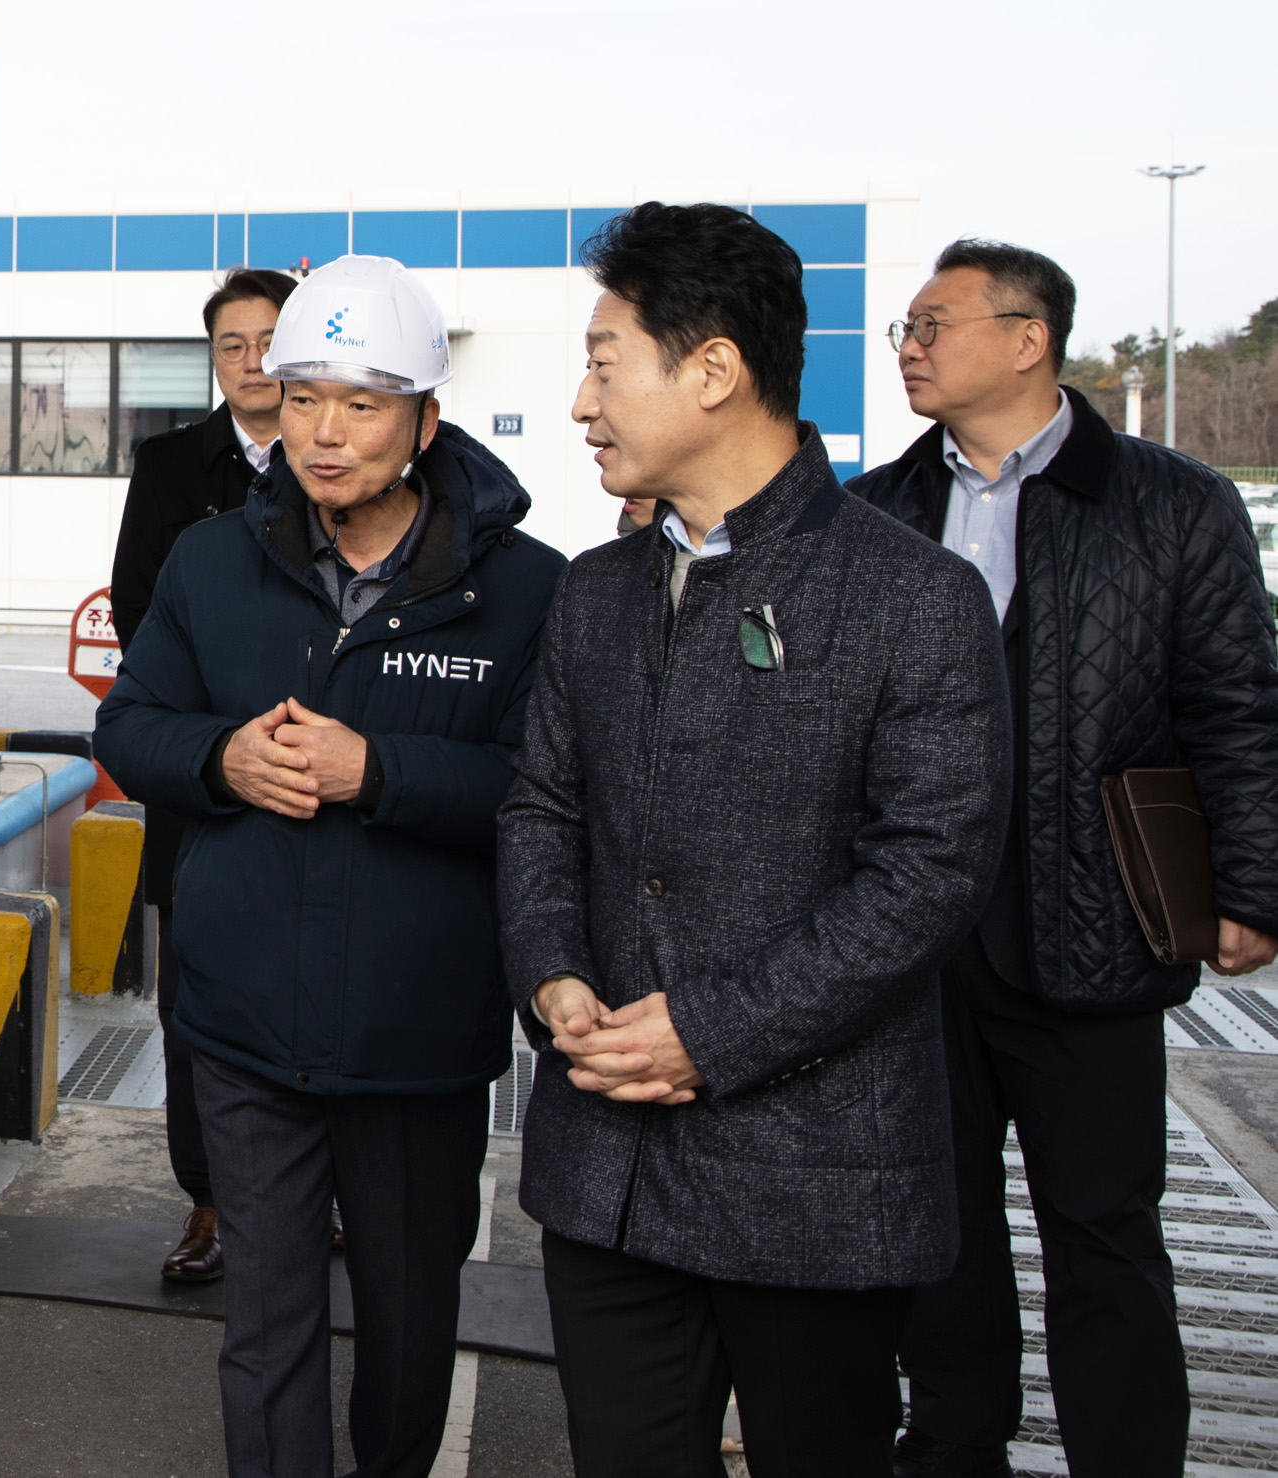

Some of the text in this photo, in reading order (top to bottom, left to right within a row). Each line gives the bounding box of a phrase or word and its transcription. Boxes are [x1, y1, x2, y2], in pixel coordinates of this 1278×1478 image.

[334, 335, 366, 348] HyNet
[497, 419, 519, 432] 233
[382, 651, 494, 683] HYNET
